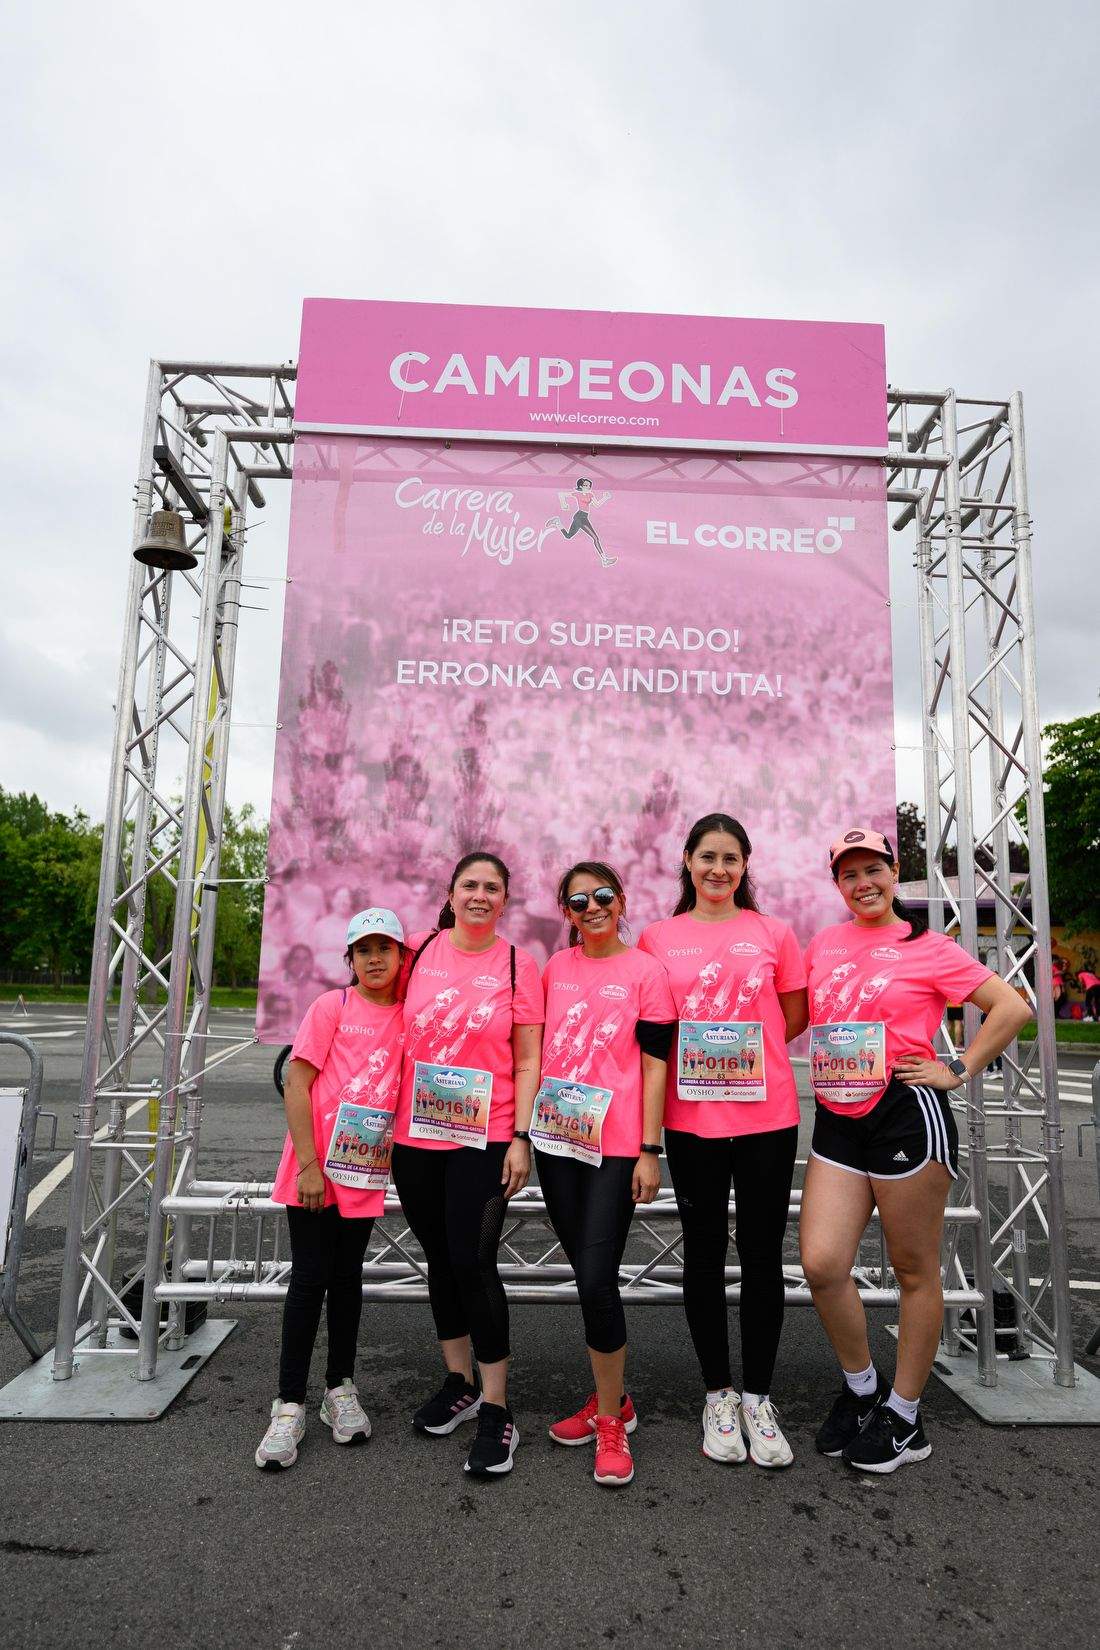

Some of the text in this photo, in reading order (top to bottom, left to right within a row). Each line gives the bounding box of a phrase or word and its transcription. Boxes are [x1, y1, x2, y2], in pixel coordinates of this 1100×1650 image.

[389, 351, 799, 409] CAMPEONAS
[529, 410, 660, 426] www.elcorreo.com
[395, 477, 514, 513] Carrera
[422, 511, 557, 566] de la Mujer
[646, 520, 843, 554] EL CORREO
[442, 618, 739, 652] ¡RETO SUPERADO!
[397, 660, 784, 697] ERRONKA GAINDITUTA!
[667, 947, 703, 957] OYSHO
[340, 1025, 375, 1036] OYSHO
[705, 1056, 738, 1070] 016
[830, 1057, 857, 1071] 016
[686, 1088, 715, 1096] OYSHO
[435, 1098, 463, 1114] 016
[555, 1113, 579, 1130] 016
[536, 1141, 563, 1150] OYSHO
[332, 1172, 359, 1182] OYSHO
